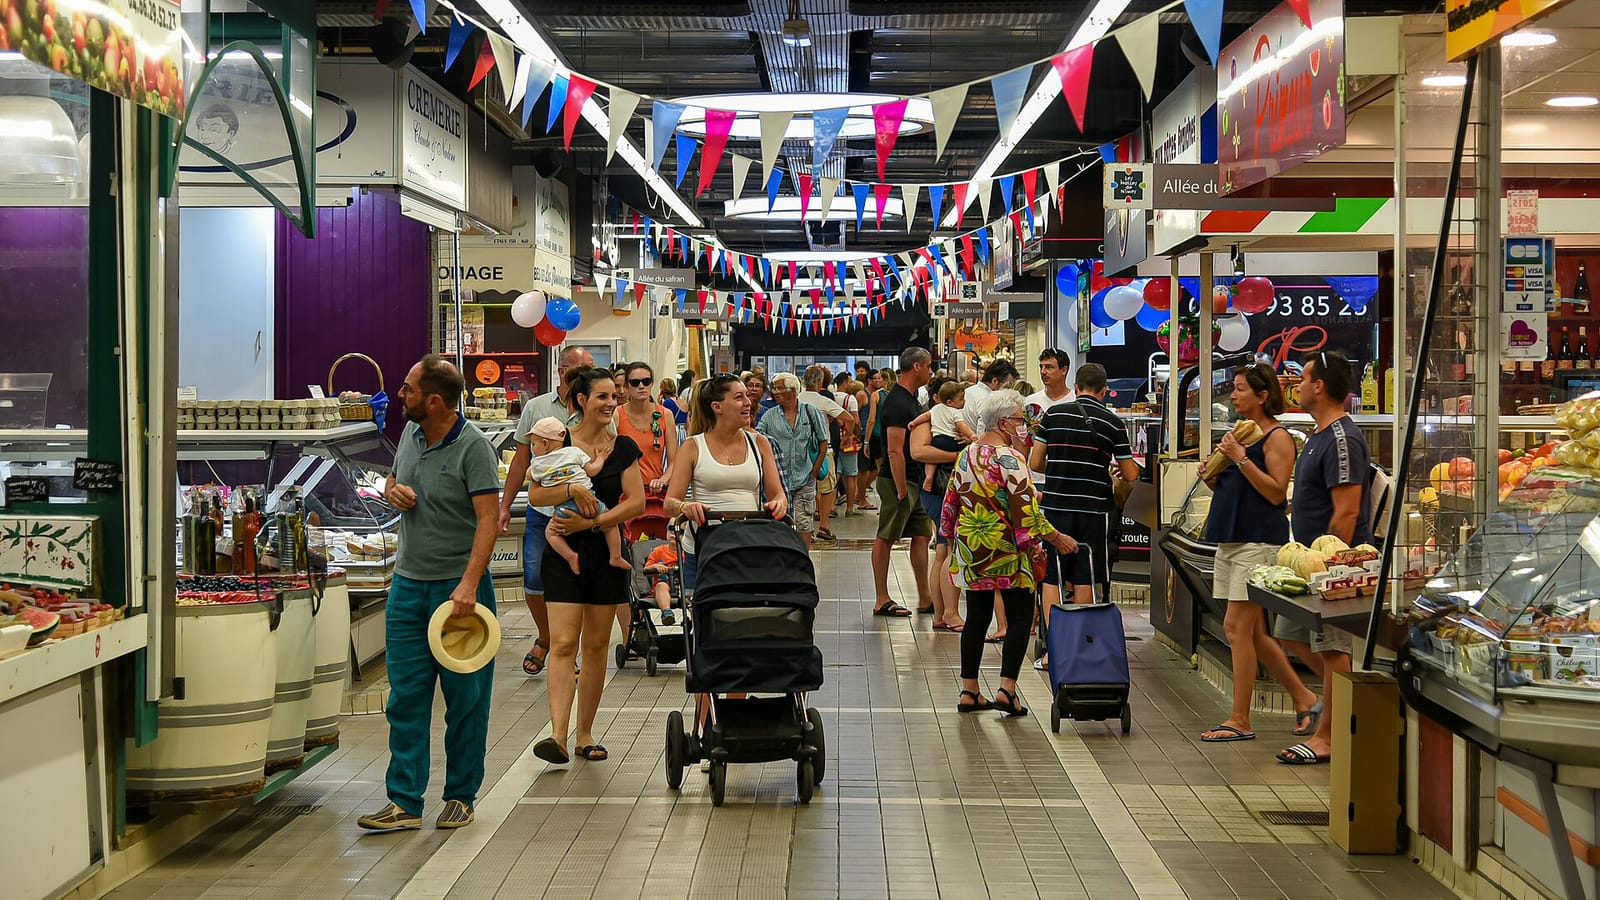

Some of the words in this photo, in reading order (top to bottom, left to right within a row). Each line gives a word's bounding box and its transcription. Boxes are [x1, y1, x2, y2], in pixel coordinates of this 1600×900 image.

[407, 79, 462, 139] CREMERIE
[1163, 178, 1200, 194] Allée
[638, 275, 655, 283] Allée
[655, 275, 665, 283] du
[665, 275, 685, 283] safran
[1301, 296, 1330, 317] 85
